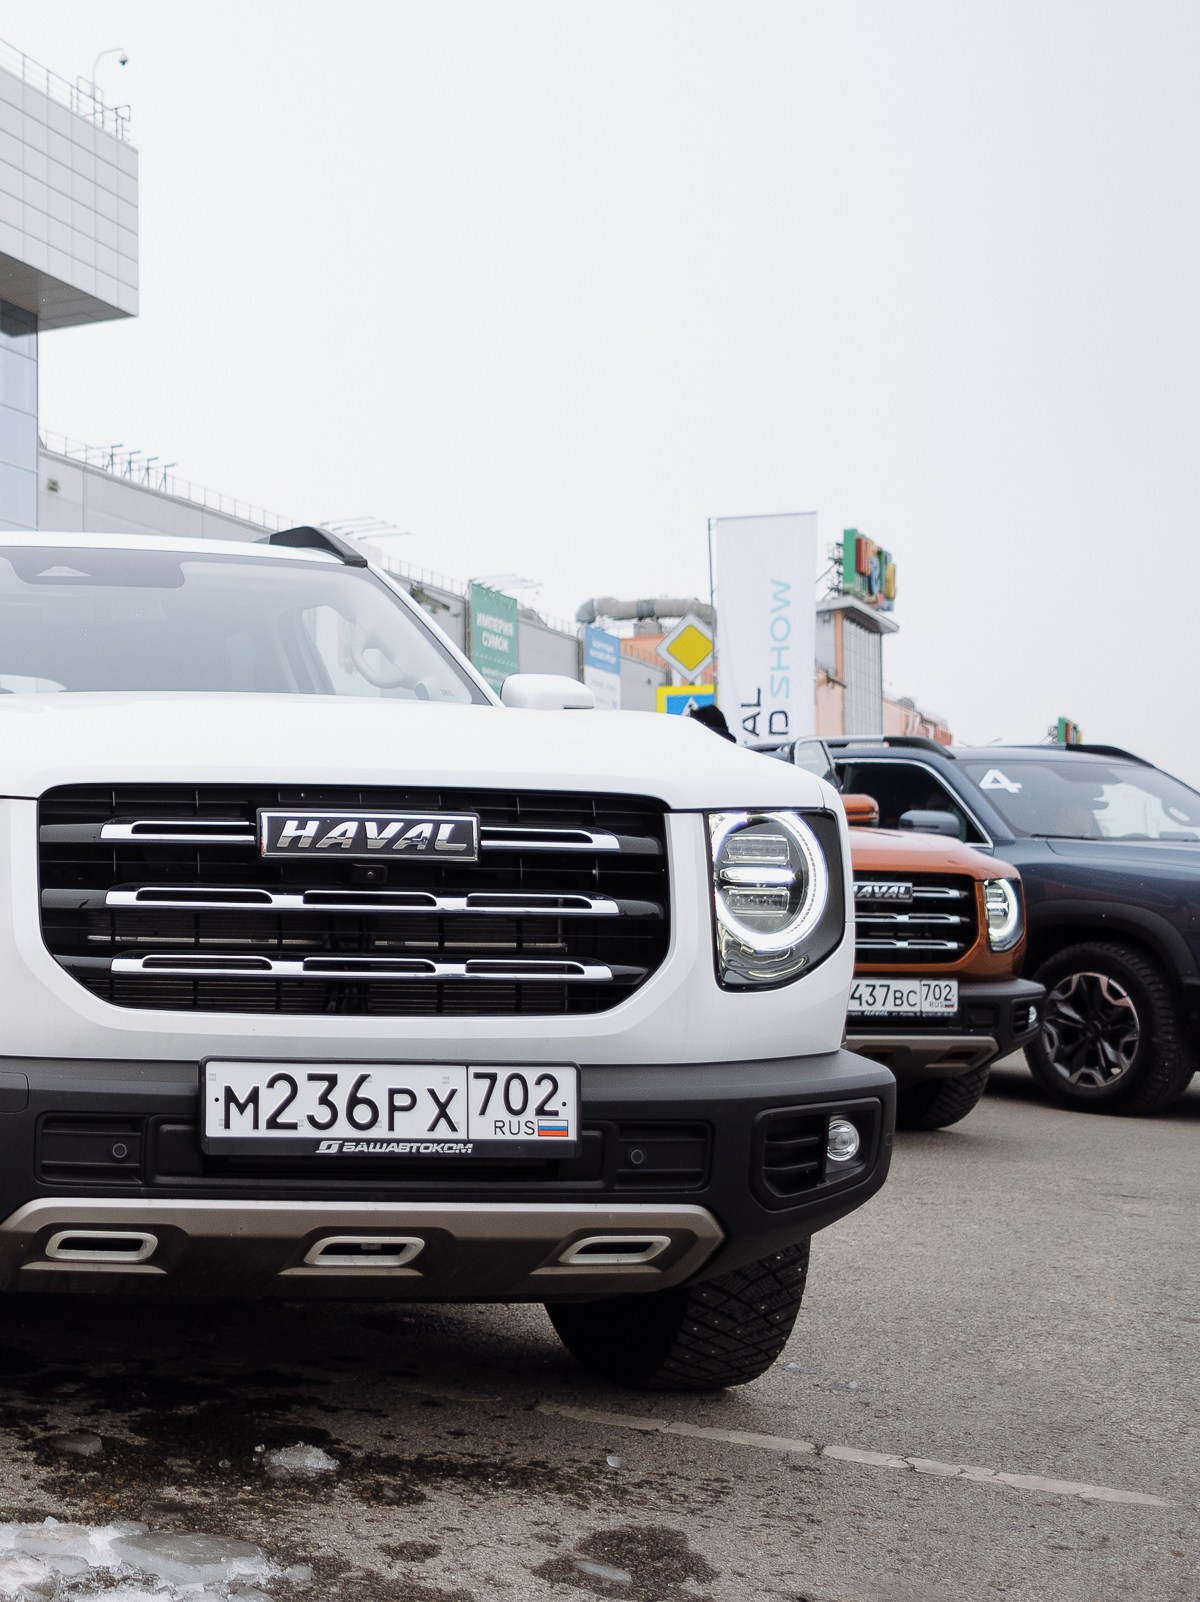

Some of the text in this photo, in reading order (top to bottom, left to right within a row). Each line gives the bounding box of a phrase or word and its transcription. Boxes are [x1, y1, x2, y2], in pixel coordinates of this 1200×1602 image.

[770, 578, 791, 698] SHOW
[978, 769, 1023, 793] 4
[276, 820, 468, 851] HAVAL
[923, 984, 952, 1001] 702
[473, 1072, 560, 1117] 702
[494, 1120, 535, 1135] RUS
[342, 1142, 473, 1154] БАШАВТОКОМ
